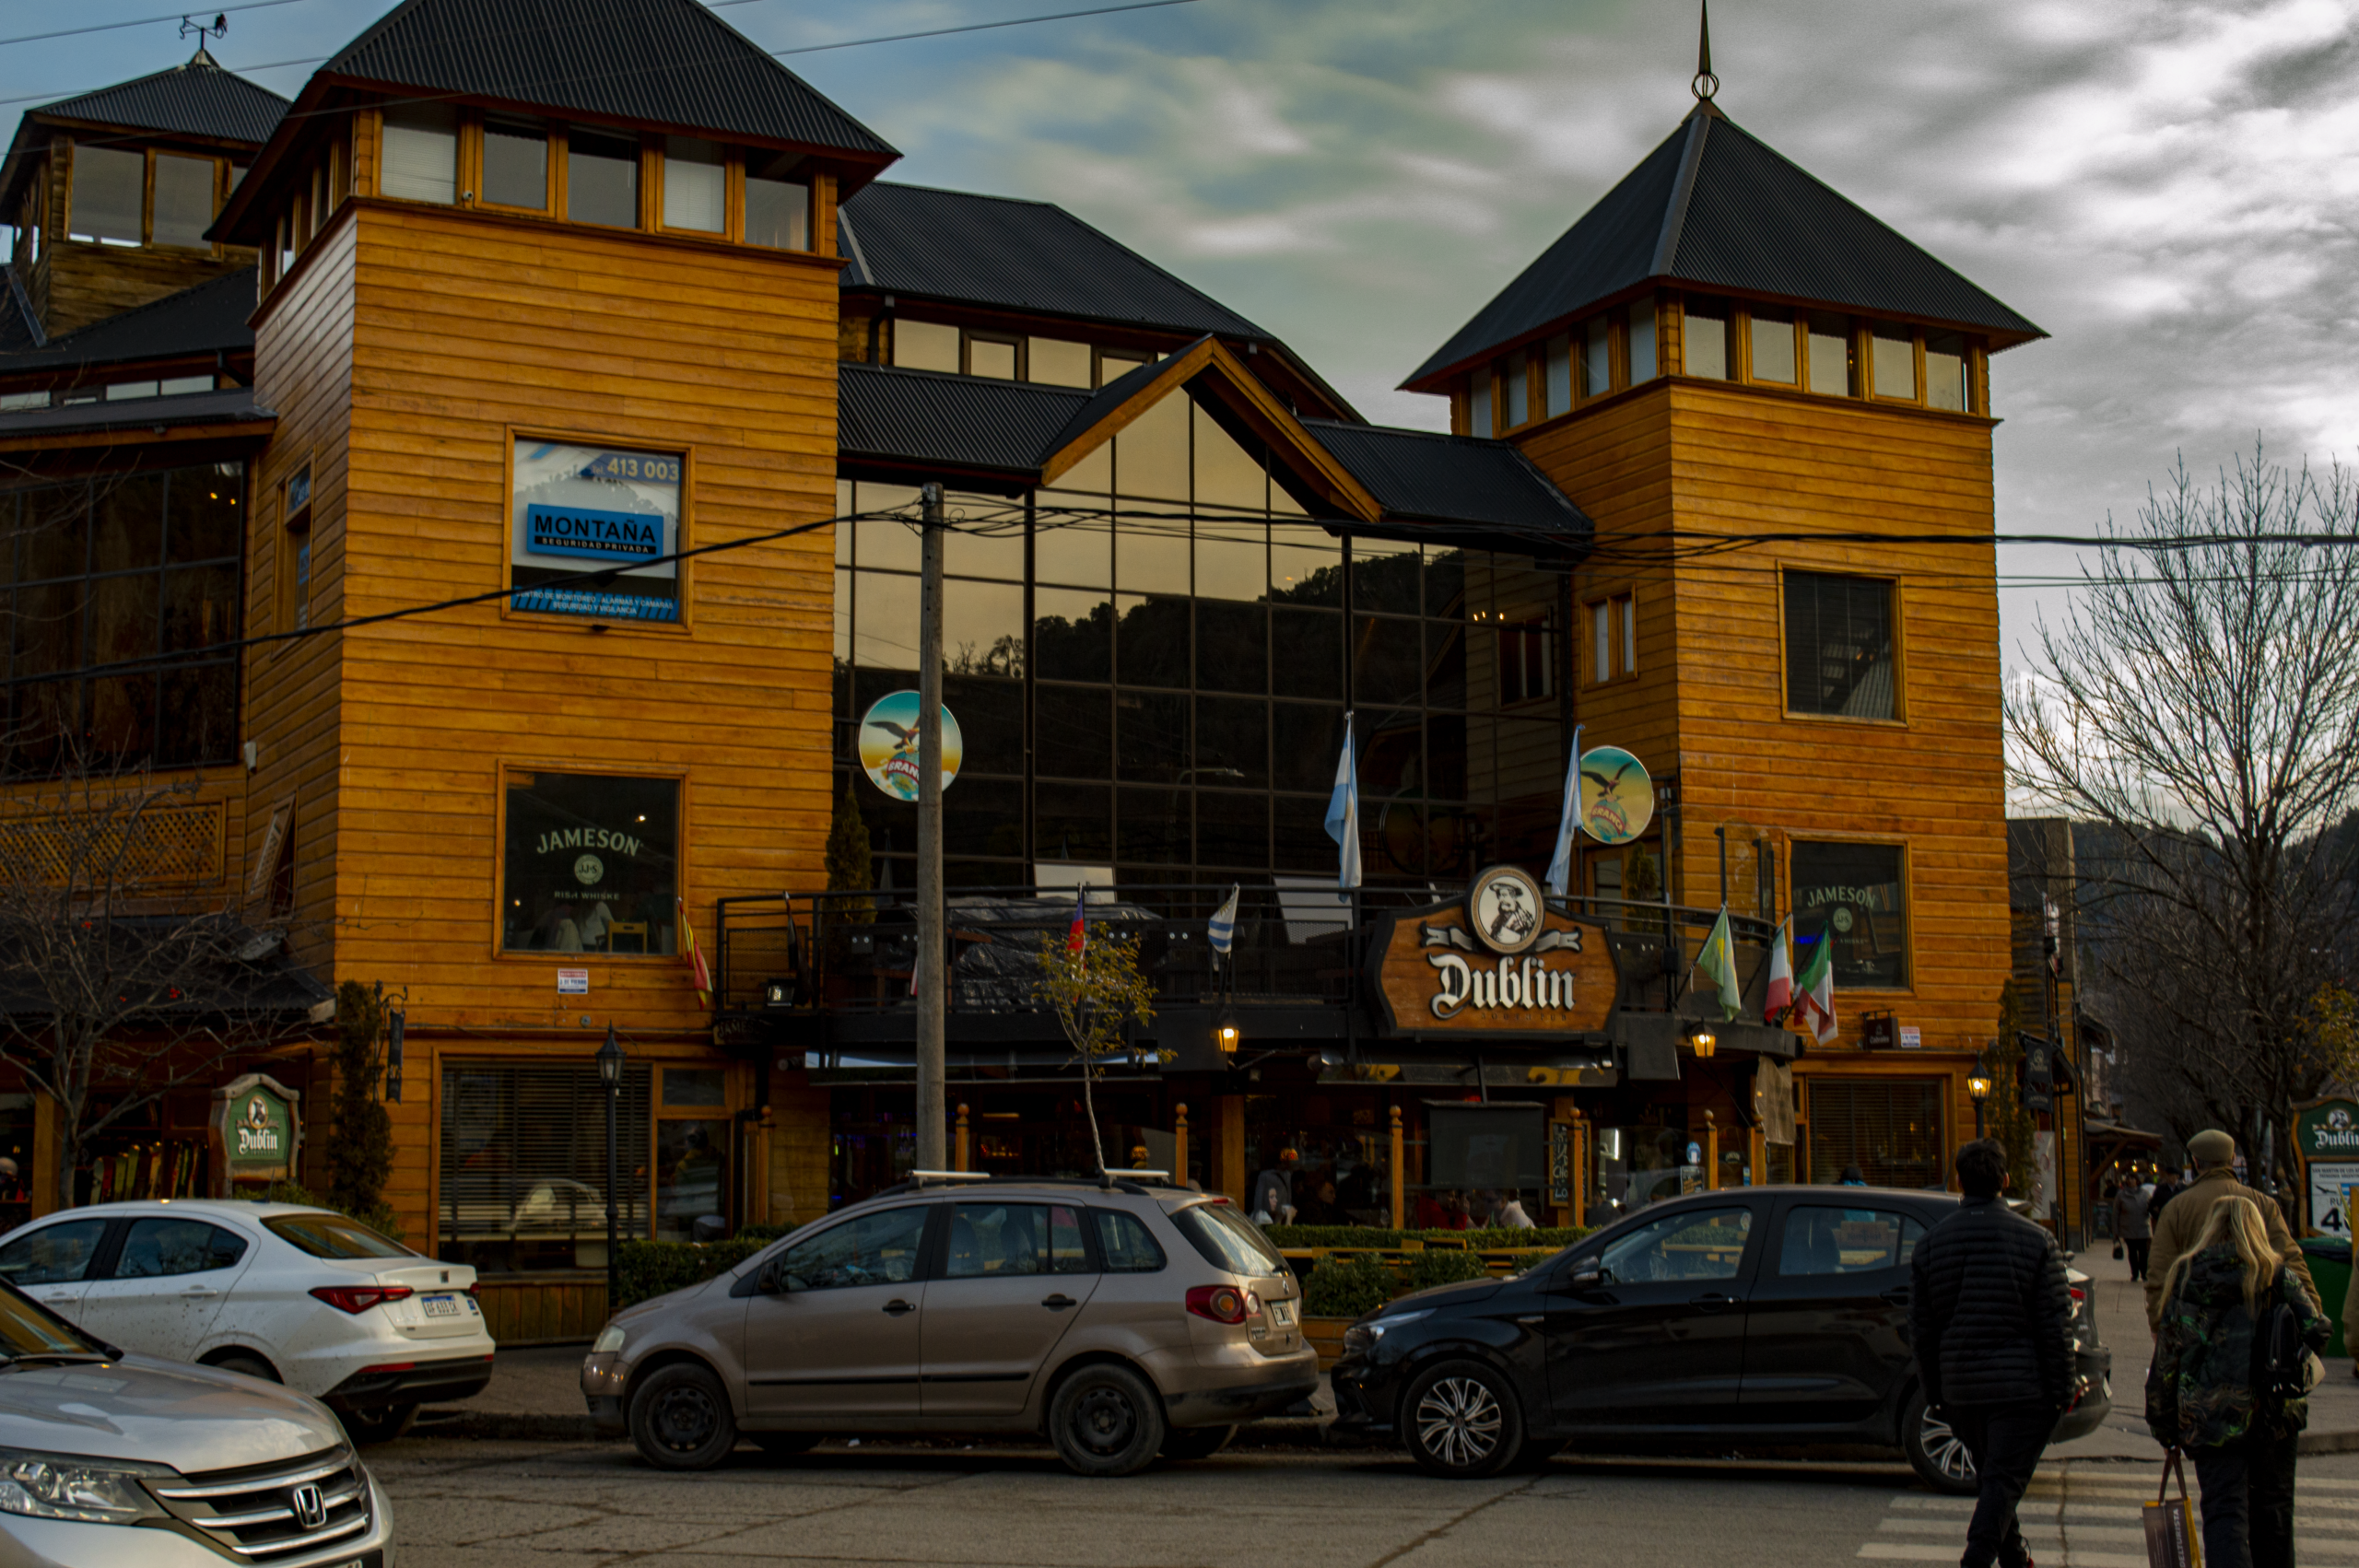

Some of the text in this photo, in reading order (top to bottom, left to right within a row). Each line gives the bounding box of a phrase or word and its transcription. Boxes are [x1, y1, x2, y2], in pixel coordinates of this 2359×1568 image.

[607, 458, 638, 477] 413
[644, 463, 679, 481] 003
[534, 515, 656, 544] MONTAÑA
[542, 537, 649, 554] SEGURIDAD PRIVADA
[545, 591, 555, 600] DE
[556, 592, 596, 603] MONITOREO
[601, 596, 633, 606] ALARMAS
[640, 600, 674, 610] CAMARAS
[553, 601, 593, 611] SEGURIDAD
[599, 604, 638, 614] VIGILANCIA
[887, 760, 920, 781] BRAN
[536, 827, 640, 857] JAMESON
[1807, 885, 1876, 909] JAMESON
[1428, 952, 1577, 1021] Dublin
[238, 1128, 278, 1155] Dublin
